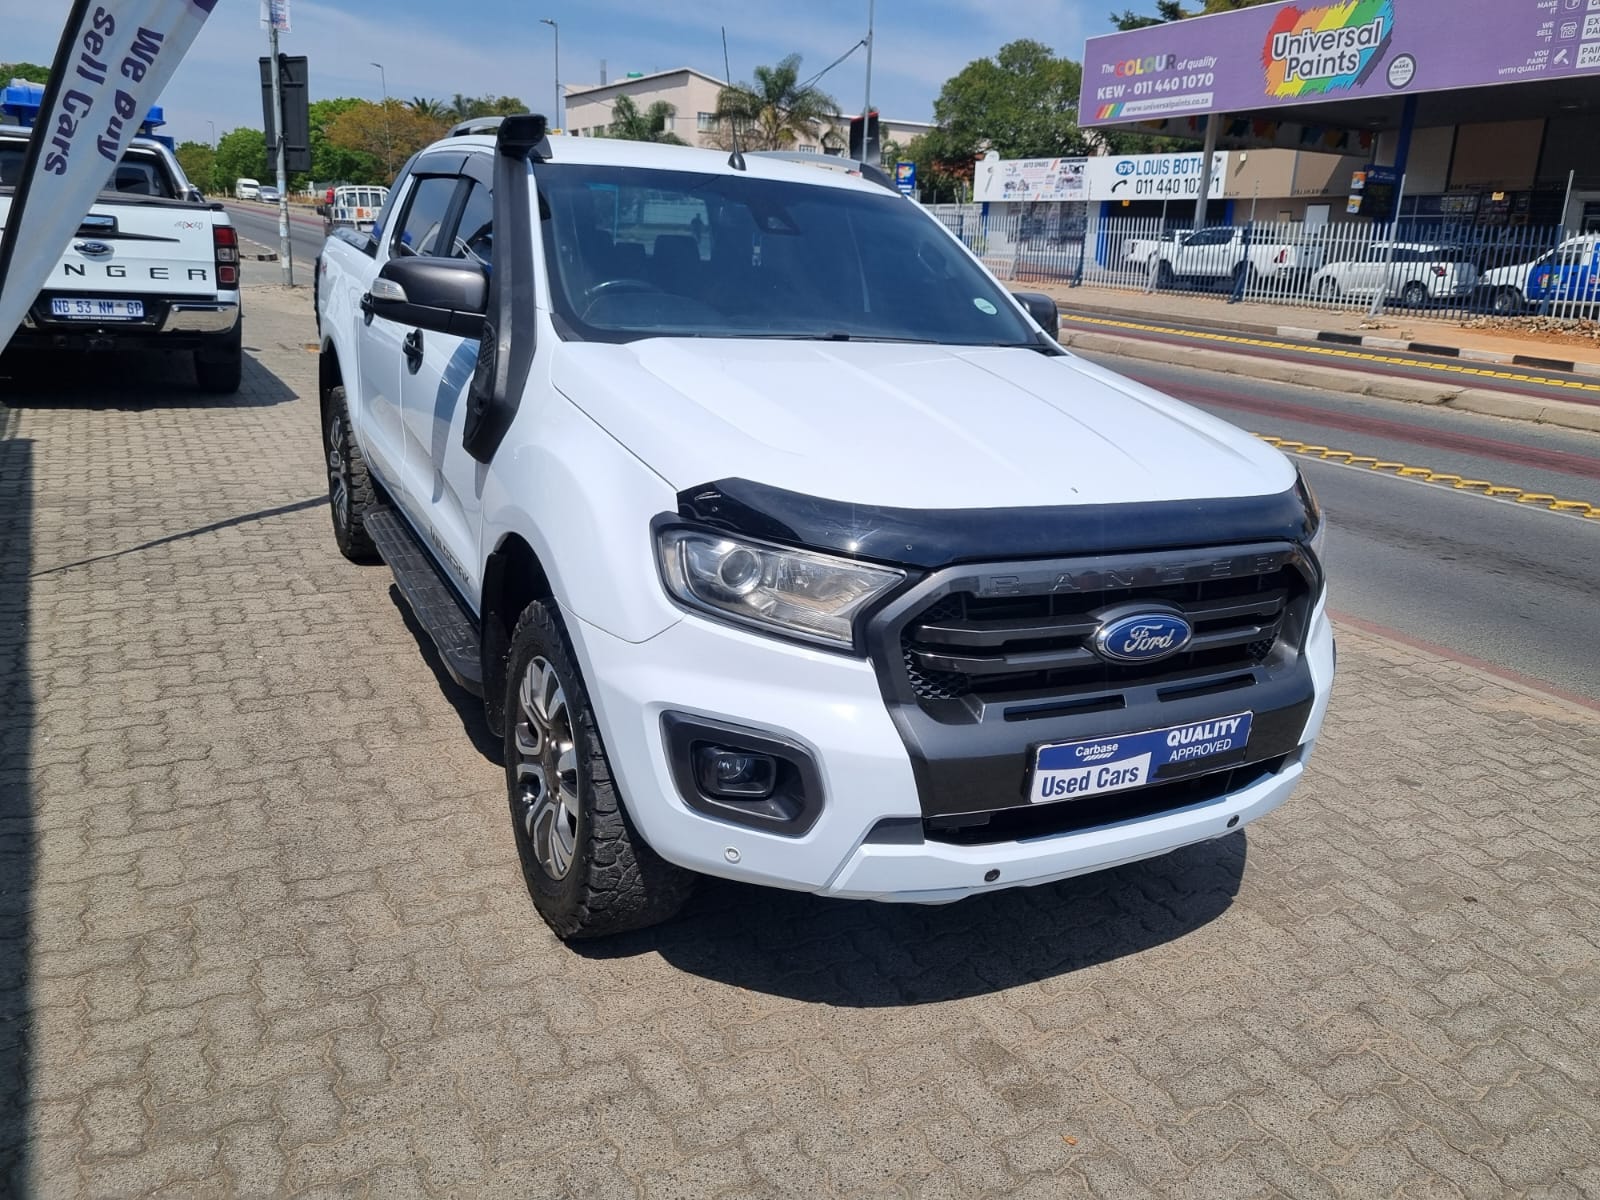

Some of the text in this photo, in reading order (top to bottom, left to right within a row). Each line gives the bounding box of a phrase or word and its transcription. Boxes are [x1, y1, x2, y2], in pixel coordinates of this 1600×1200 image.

[1536, 29, 1553, 37] SELL
[1542, 21, 1555, 29] WE
[1273, 19, 1382, 58] Universal
[1526, 57, 1548, 65] PAINT
[1534, 49, 1550, 57] YOU
[1101, 54, 1217, 78] The COLOUR of quality
[1286, 51, 1358, 80] Paints
[1498, 64, 1547, 75] WITH QUALITY
[97, 26, 165, 163] We Buy
[1097, 84, 1126, 100] KEW
[1134, 81, 1153, 95] 011
[1155, 77, 1179, 92] 440
[1182, 73, 1214, 89] 1070
[1125, 98, 1209, 112] www.universalpaints.co.za
[44, 89, 94, 175] Cars
[1136, 159, 1170, 176] LOUIS
[1172, 157, 1204, 175] BOTH
[1136, 179, 1154, 194] 011
[1156, 178, 1180, 194] 440
[64, 263, 207, 281] NGER
[76, 300, 92, 314] 53
[127, 302, 142, 315] GP
[1124, 623, 1176, 653] Ford
[1166, 717, 1242, 748] QUALITY
[1075, 742, 1119, 758] Carbase
[1168, 738, 1232, 763] APPROVED
[1041, 765, 1140, 798] Used Cars
